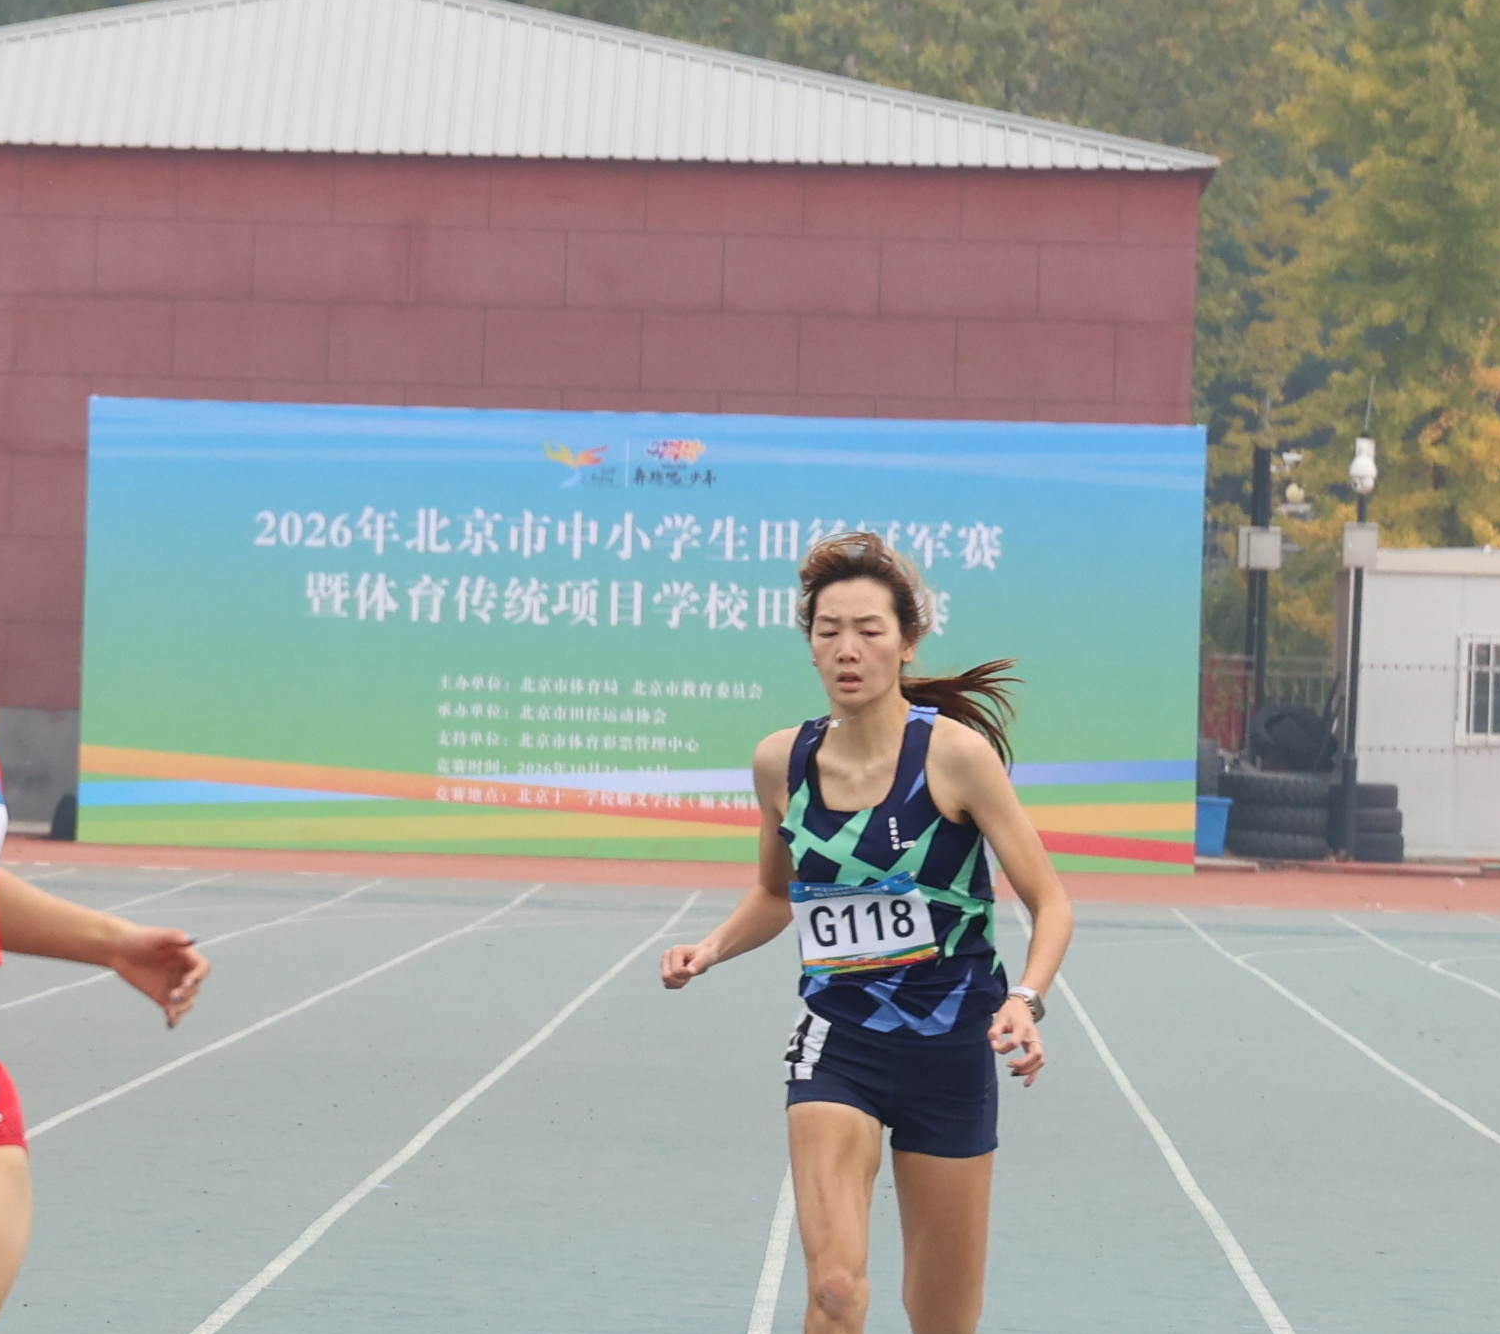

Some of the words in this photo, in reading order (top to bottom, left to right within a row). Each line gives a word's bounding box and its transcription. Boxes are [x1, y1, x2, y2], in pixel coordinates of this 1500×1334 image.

[253, 507, 1004, 571] 2026年北京市中小学生田军赛
[809, 899, 916, 948] G118
